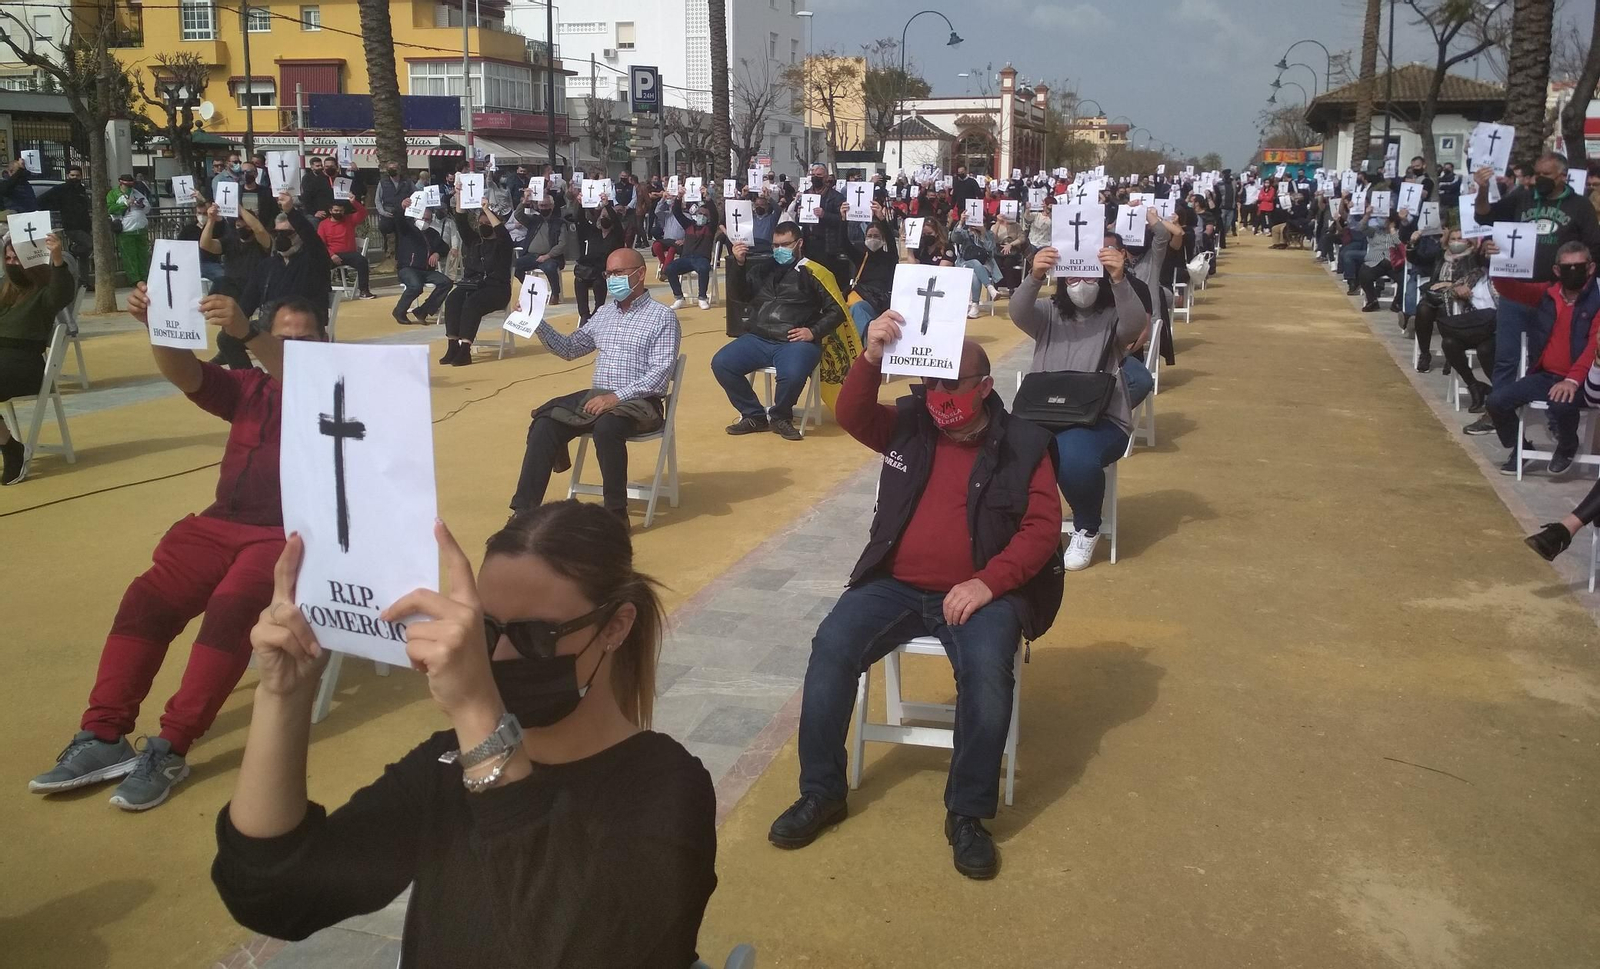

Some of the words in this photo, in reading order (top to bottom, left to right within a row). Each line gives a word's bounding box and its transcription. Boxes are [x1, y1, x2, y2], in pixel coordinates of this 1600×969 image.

[635, 71, 654, 98] P
[153, 328, 201, 340] HOSTELERÍA
[889, 356, 953, 369] HOSTELERÍA
[327, 580, 380, 611] R.I.P.
[300, 603, 408, 644] COMERCIO
